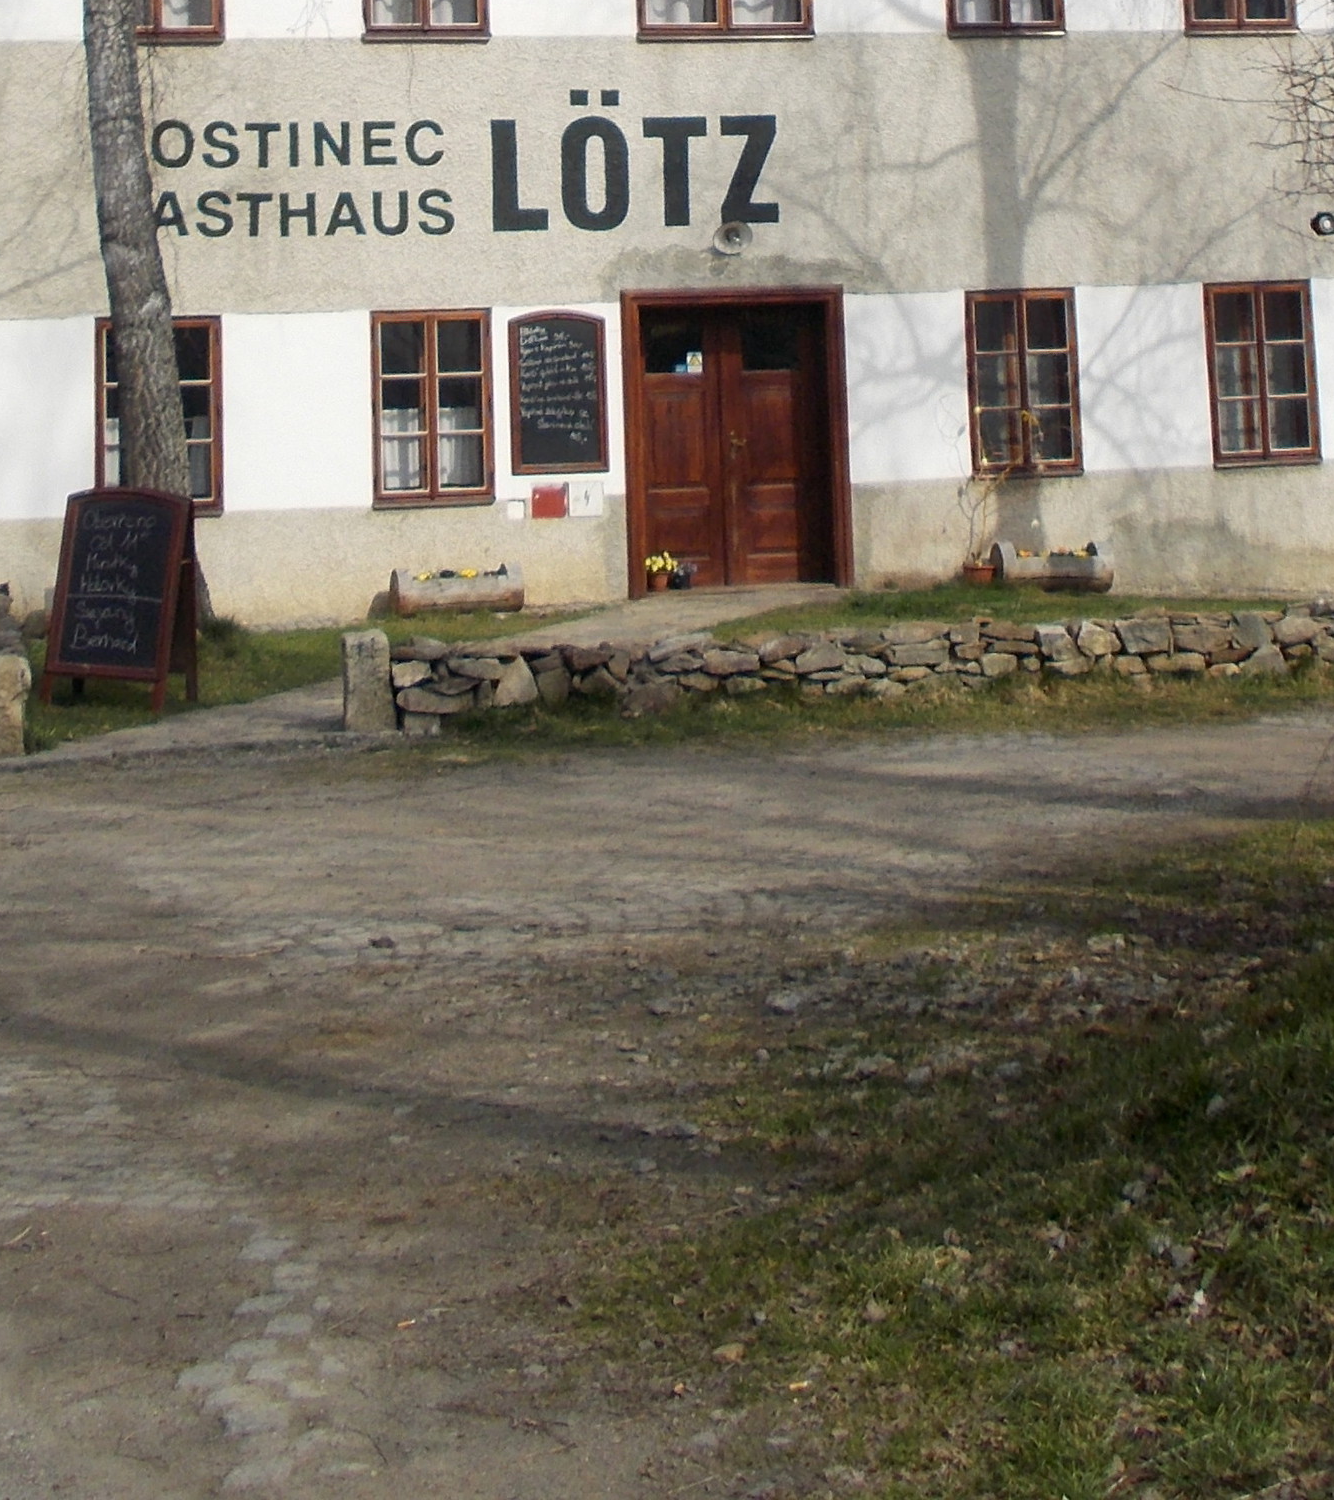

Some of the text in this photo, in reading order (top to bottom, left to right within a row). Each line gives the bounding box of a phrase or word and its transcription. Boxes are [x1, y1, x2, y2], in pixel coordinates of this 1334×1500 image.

[151, 89, 780, 232] OSTINEC LÖTZ
[154, 188, 456, 237] ASTHAUS
